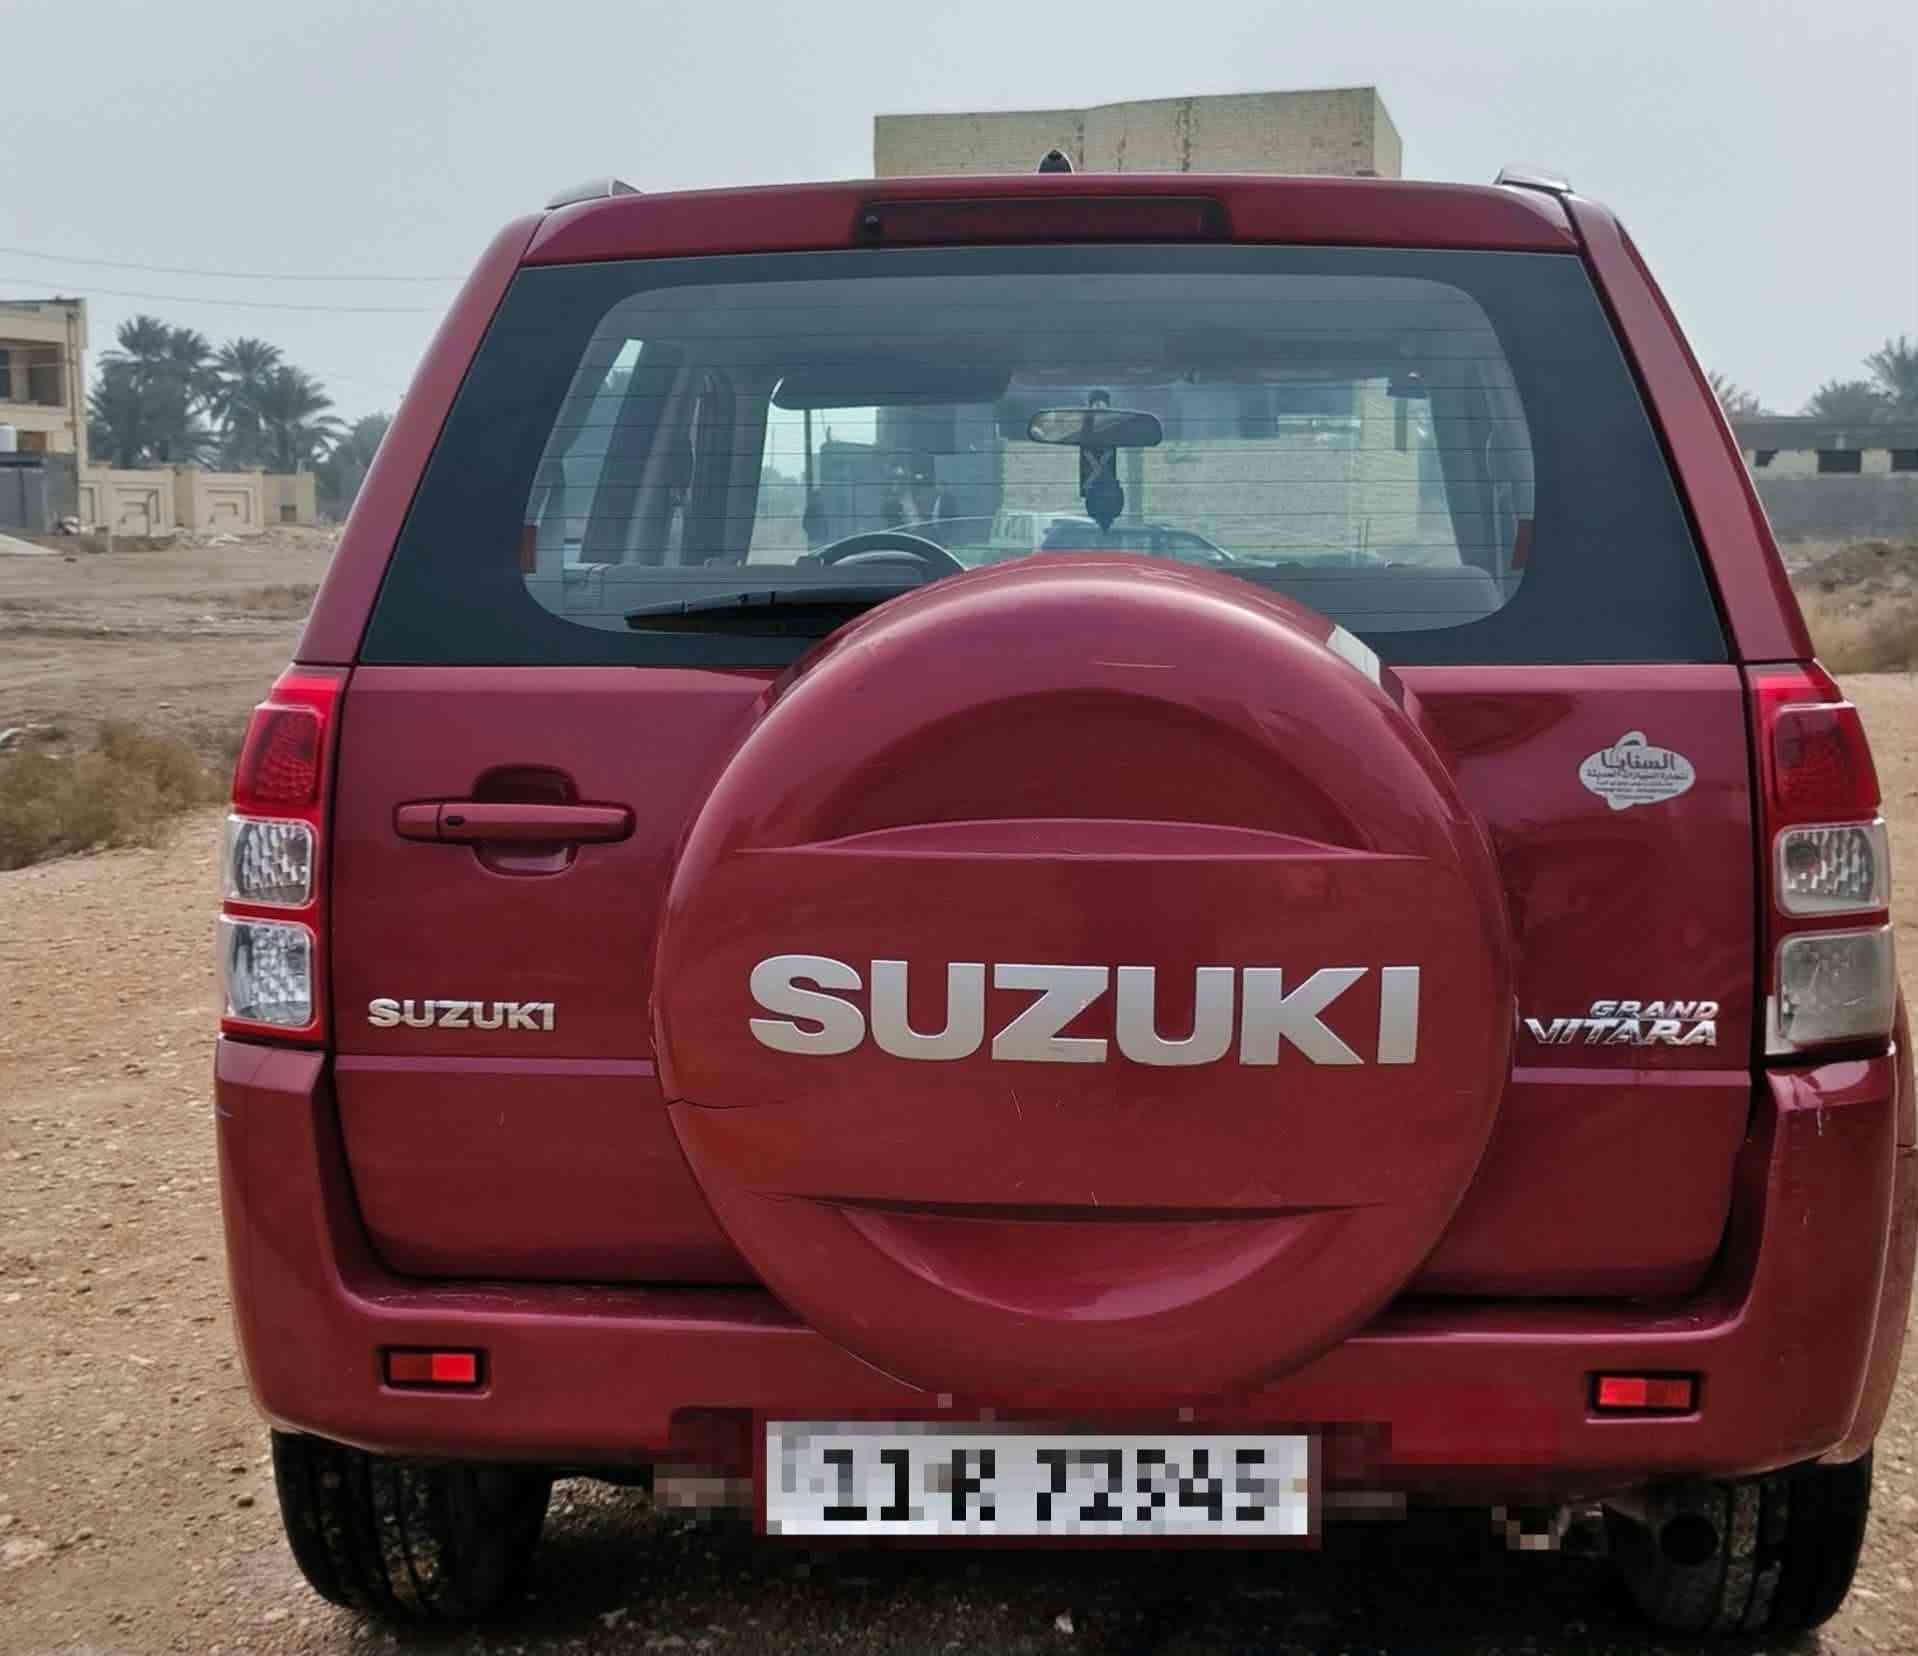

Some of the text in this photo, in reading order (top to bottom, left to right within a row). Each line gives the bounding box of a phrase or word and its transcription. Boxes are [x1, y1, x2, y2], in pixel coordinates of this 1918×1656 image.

[367, 998, 555, 1031] SUZUKI
[749, 954, 1420, 1066] SUZUKI
[1590, 1000, 1719, 1019] GRAND
[1524, 1018, 1717, 1046] VITARA
